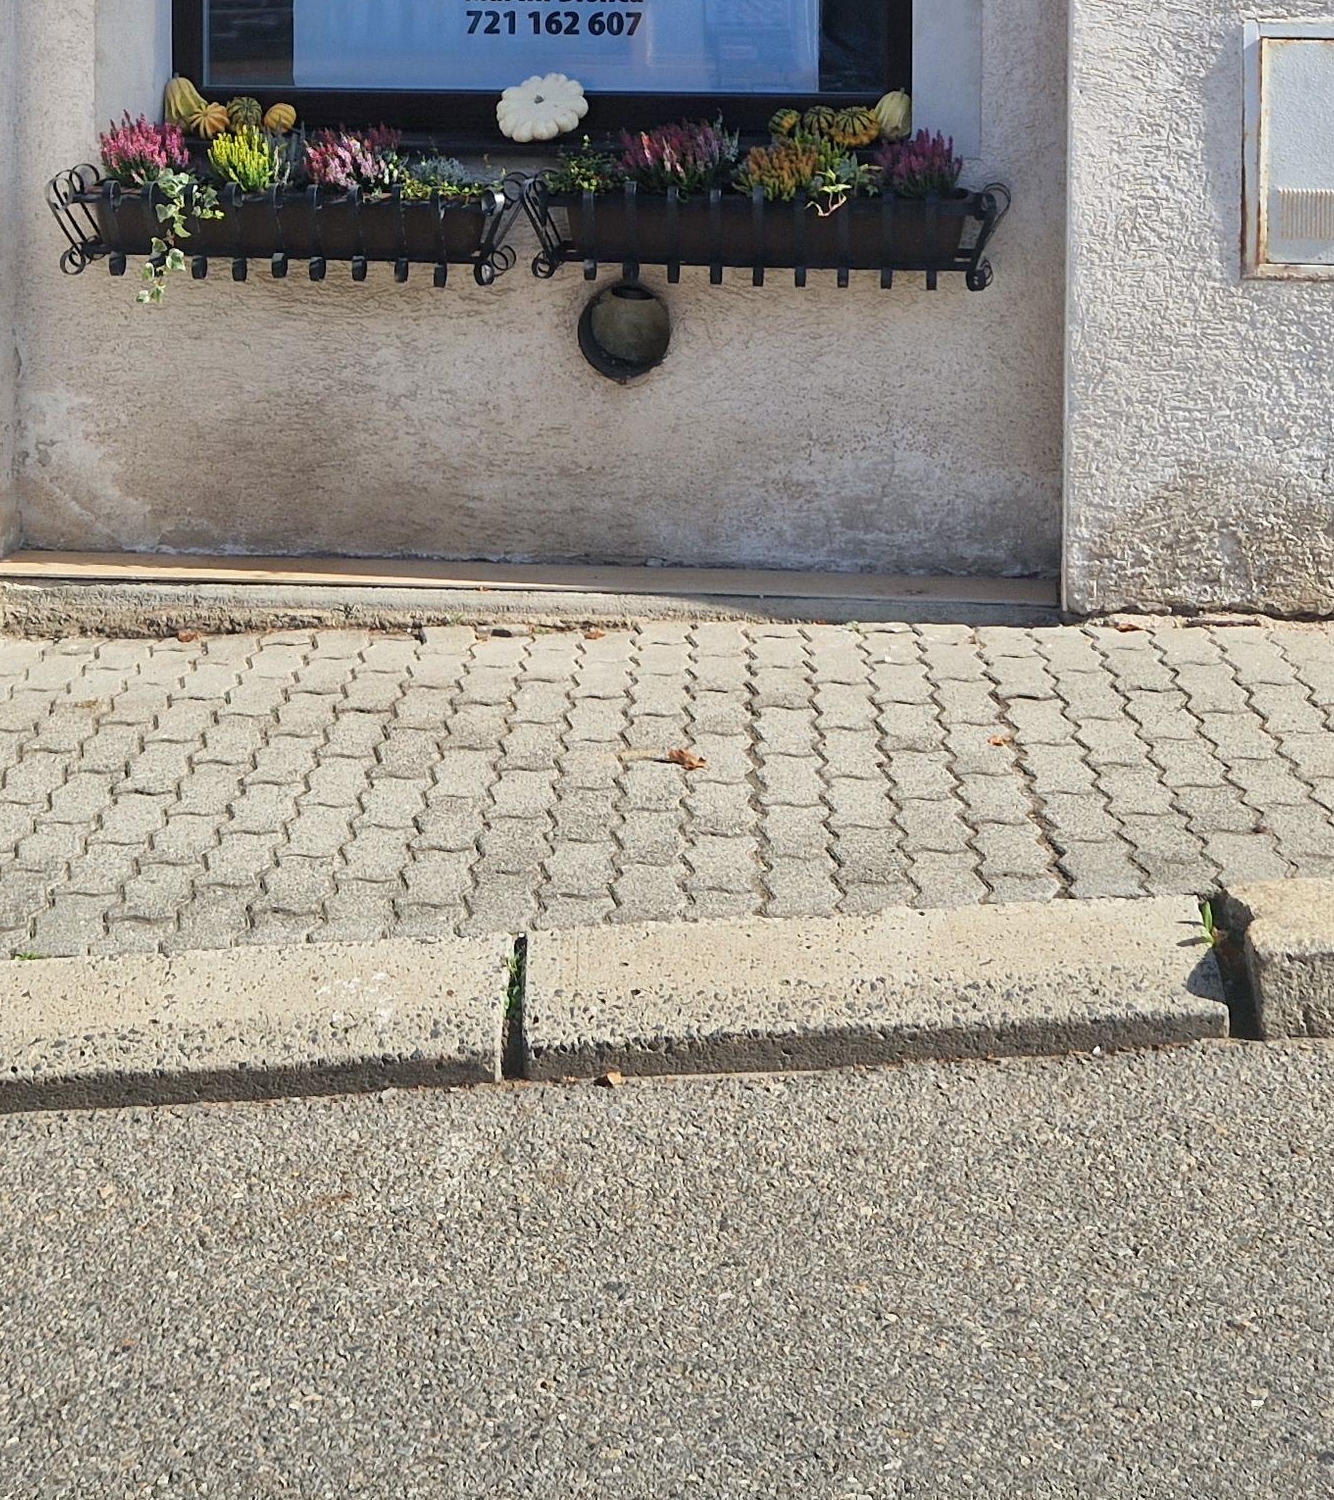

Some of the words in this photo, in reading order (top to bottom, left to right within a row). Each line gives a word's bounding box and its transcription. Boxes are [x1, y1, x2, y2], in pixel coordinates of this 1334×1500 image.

[466, 10, 516, 35] 721
[528, 11, 580, 35] 162
[587, 12, 642, 36] 607
